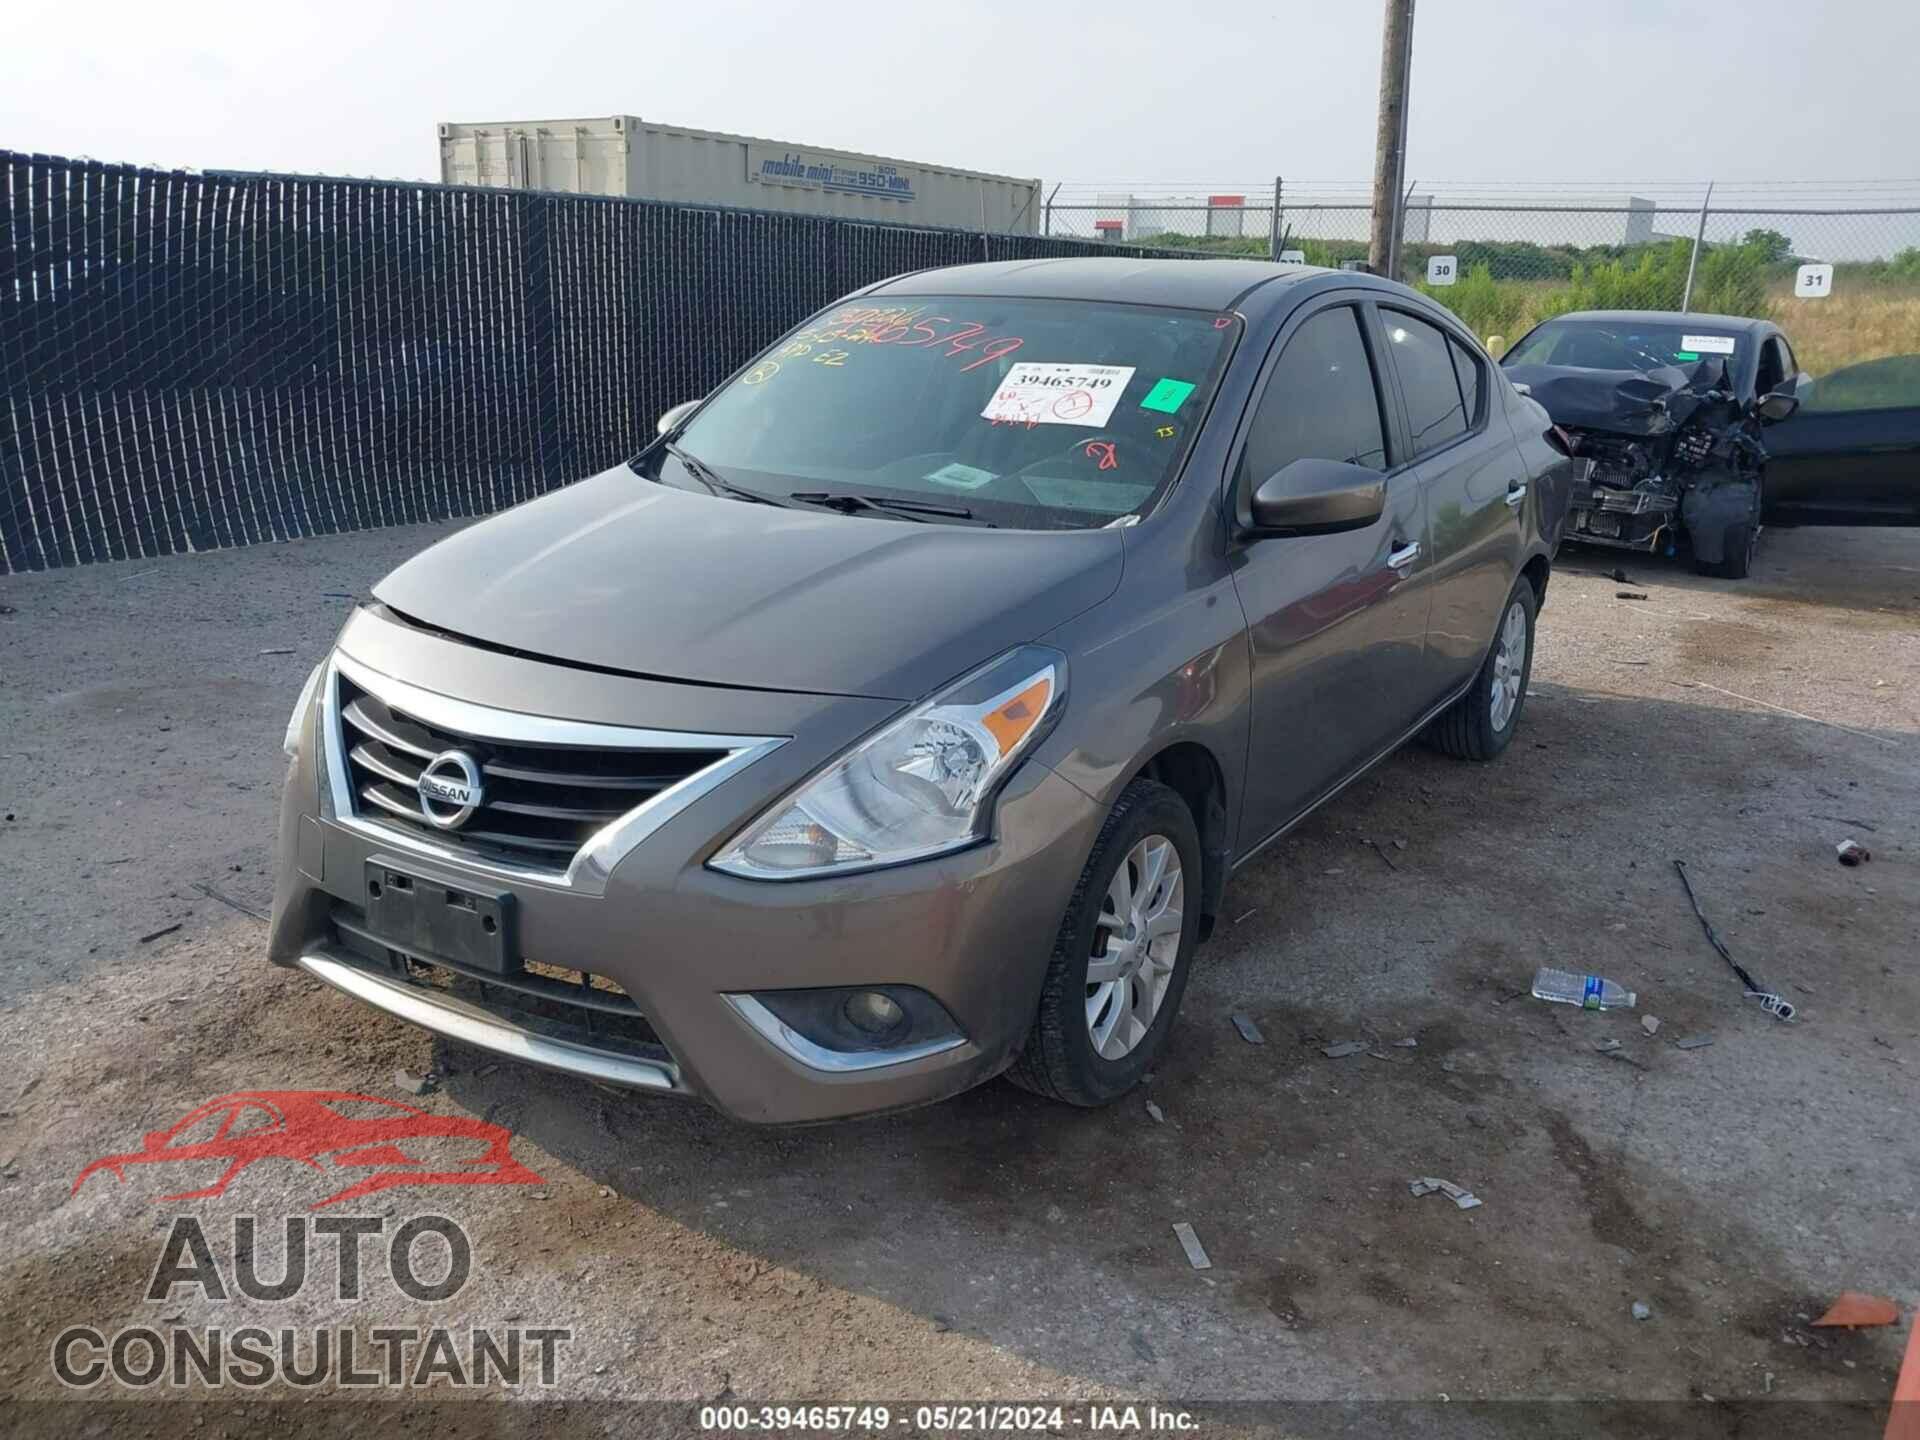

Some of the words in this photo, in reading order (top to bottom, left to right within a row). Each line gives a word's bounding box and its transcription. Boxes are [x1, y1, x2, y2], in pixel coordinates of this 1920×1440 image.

[761, 153, 805, 177] mobile
[806, 162, 834, 182] mini
[1434, 264, 1451, 276] 30
[1804, 275, 1824, 287] 31
[1014, 374, 1113, 389] 39465749
[420, 777, 471, 803] NISSAN
